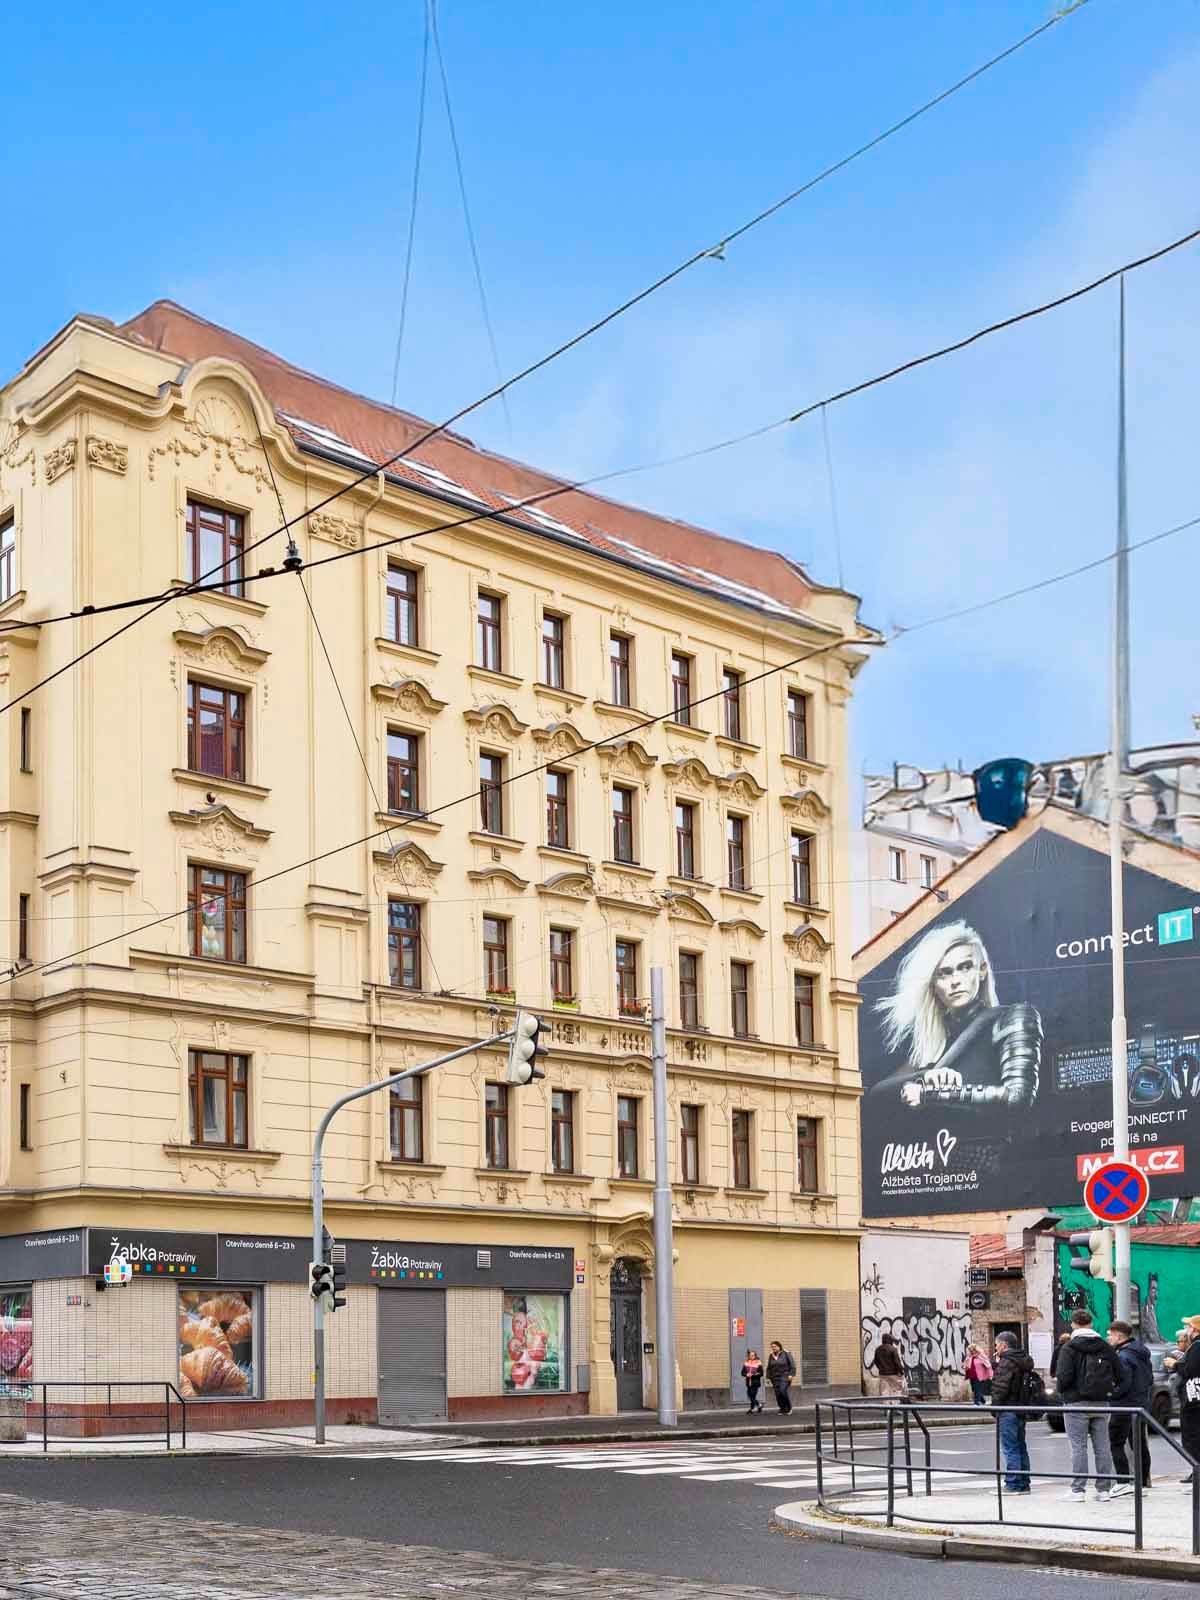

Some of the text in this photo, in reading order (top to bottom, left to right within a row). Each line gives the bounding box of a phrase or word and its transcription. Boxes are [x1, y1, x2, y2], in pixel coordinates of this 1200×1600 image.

[1056, 915, 1187, 958] connect IT
[1071, 1109, 1188, 1133] Evogear ONNECT IT
[1143, 1132, 1158, 1142] na
[1082, 1150, 1179, 1177] ML.CZ
[881, 1170, 977, 1187] Alžběta Trojanová
[110, 1237, 196, 1264] Žabka Potraviny
[225, 1240, 254, 1248] Otevřeno
[371, 1246, 442, 1271] Žabka Potraviny
